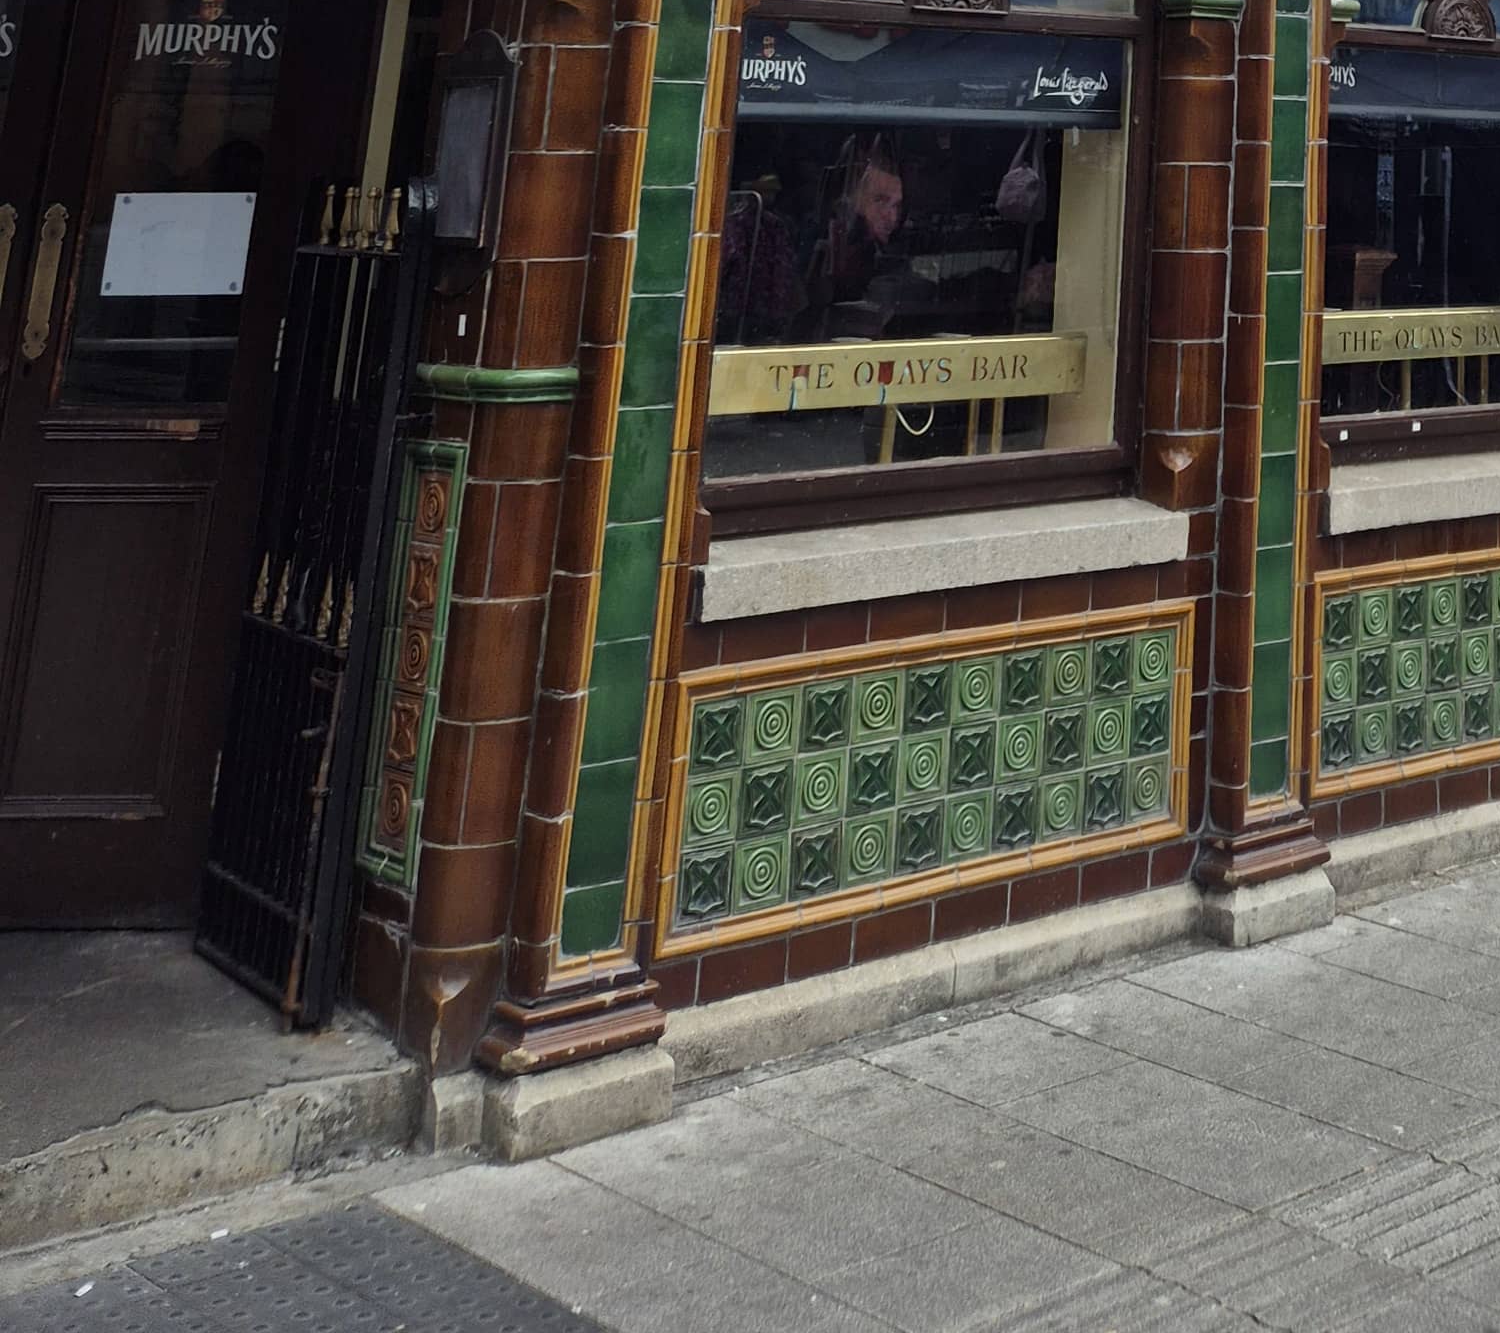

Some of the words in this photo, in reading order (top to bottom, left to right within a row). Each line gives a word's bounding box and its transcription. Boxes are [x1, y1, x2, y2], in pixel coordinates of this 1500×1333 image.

[135, 17, 280, 61] MURPHY'S
[740, 55, 807, 87] URPHY'S
[1328, 63, 1357, 87] PHY'S
[1338, 330, 1383, 353] THE
[1395, 326, 1463, 349] QUAYS
[768, 363, 835, 391] THE
[854, 358, 953, 386] QUAYS
[970, 354, 1030, 382] BAR
